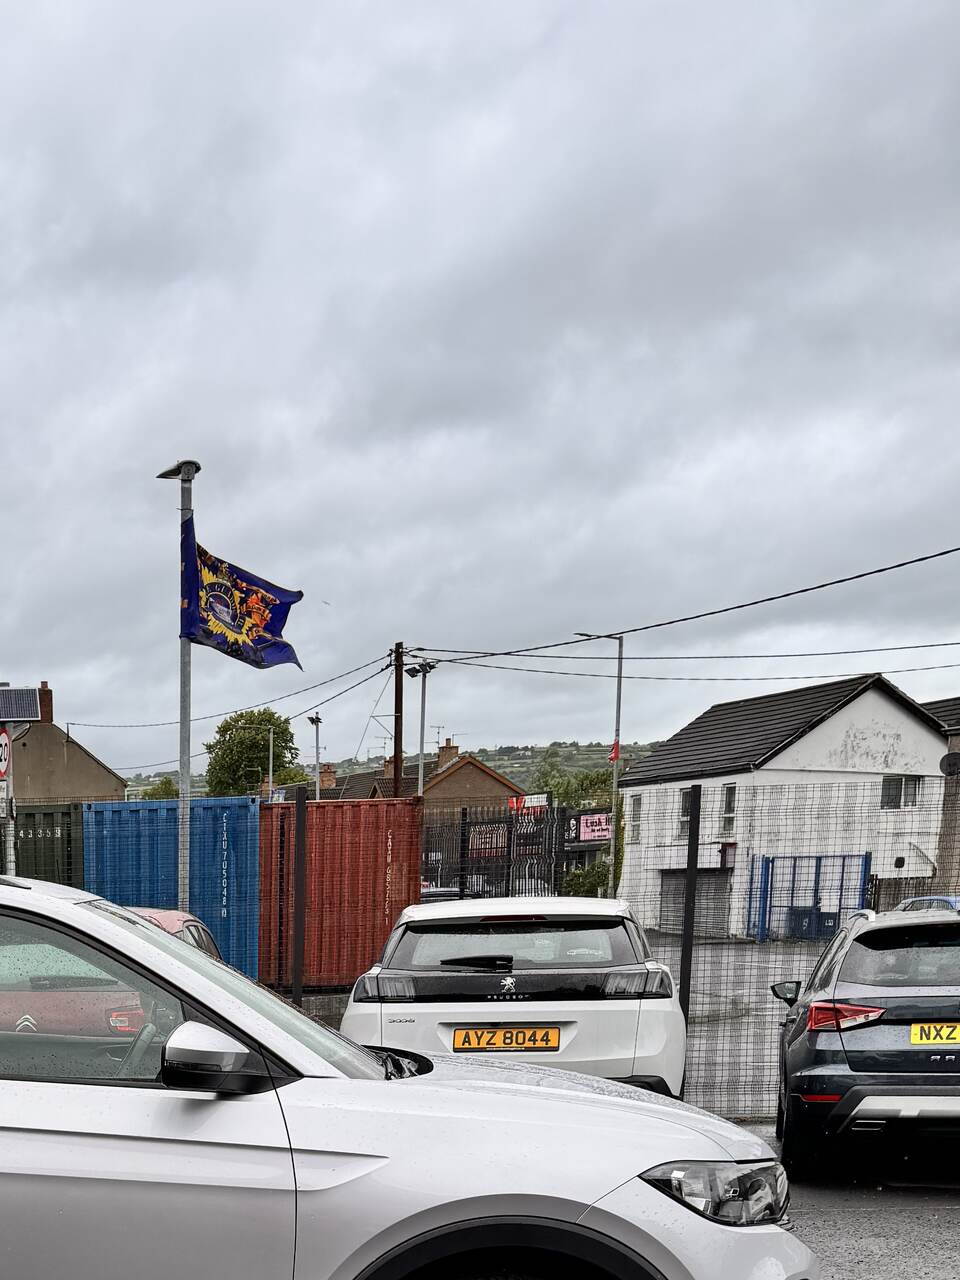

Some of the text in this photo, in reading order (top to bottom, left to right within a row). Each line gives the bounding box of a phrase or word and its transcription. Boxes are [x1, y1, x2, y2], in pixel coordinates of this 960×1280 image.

[0, 742, 9, 762] 20
[461, 1030, 551, 1046] AYZ 8044
[920, 1025, 958, 1041] NXZ
